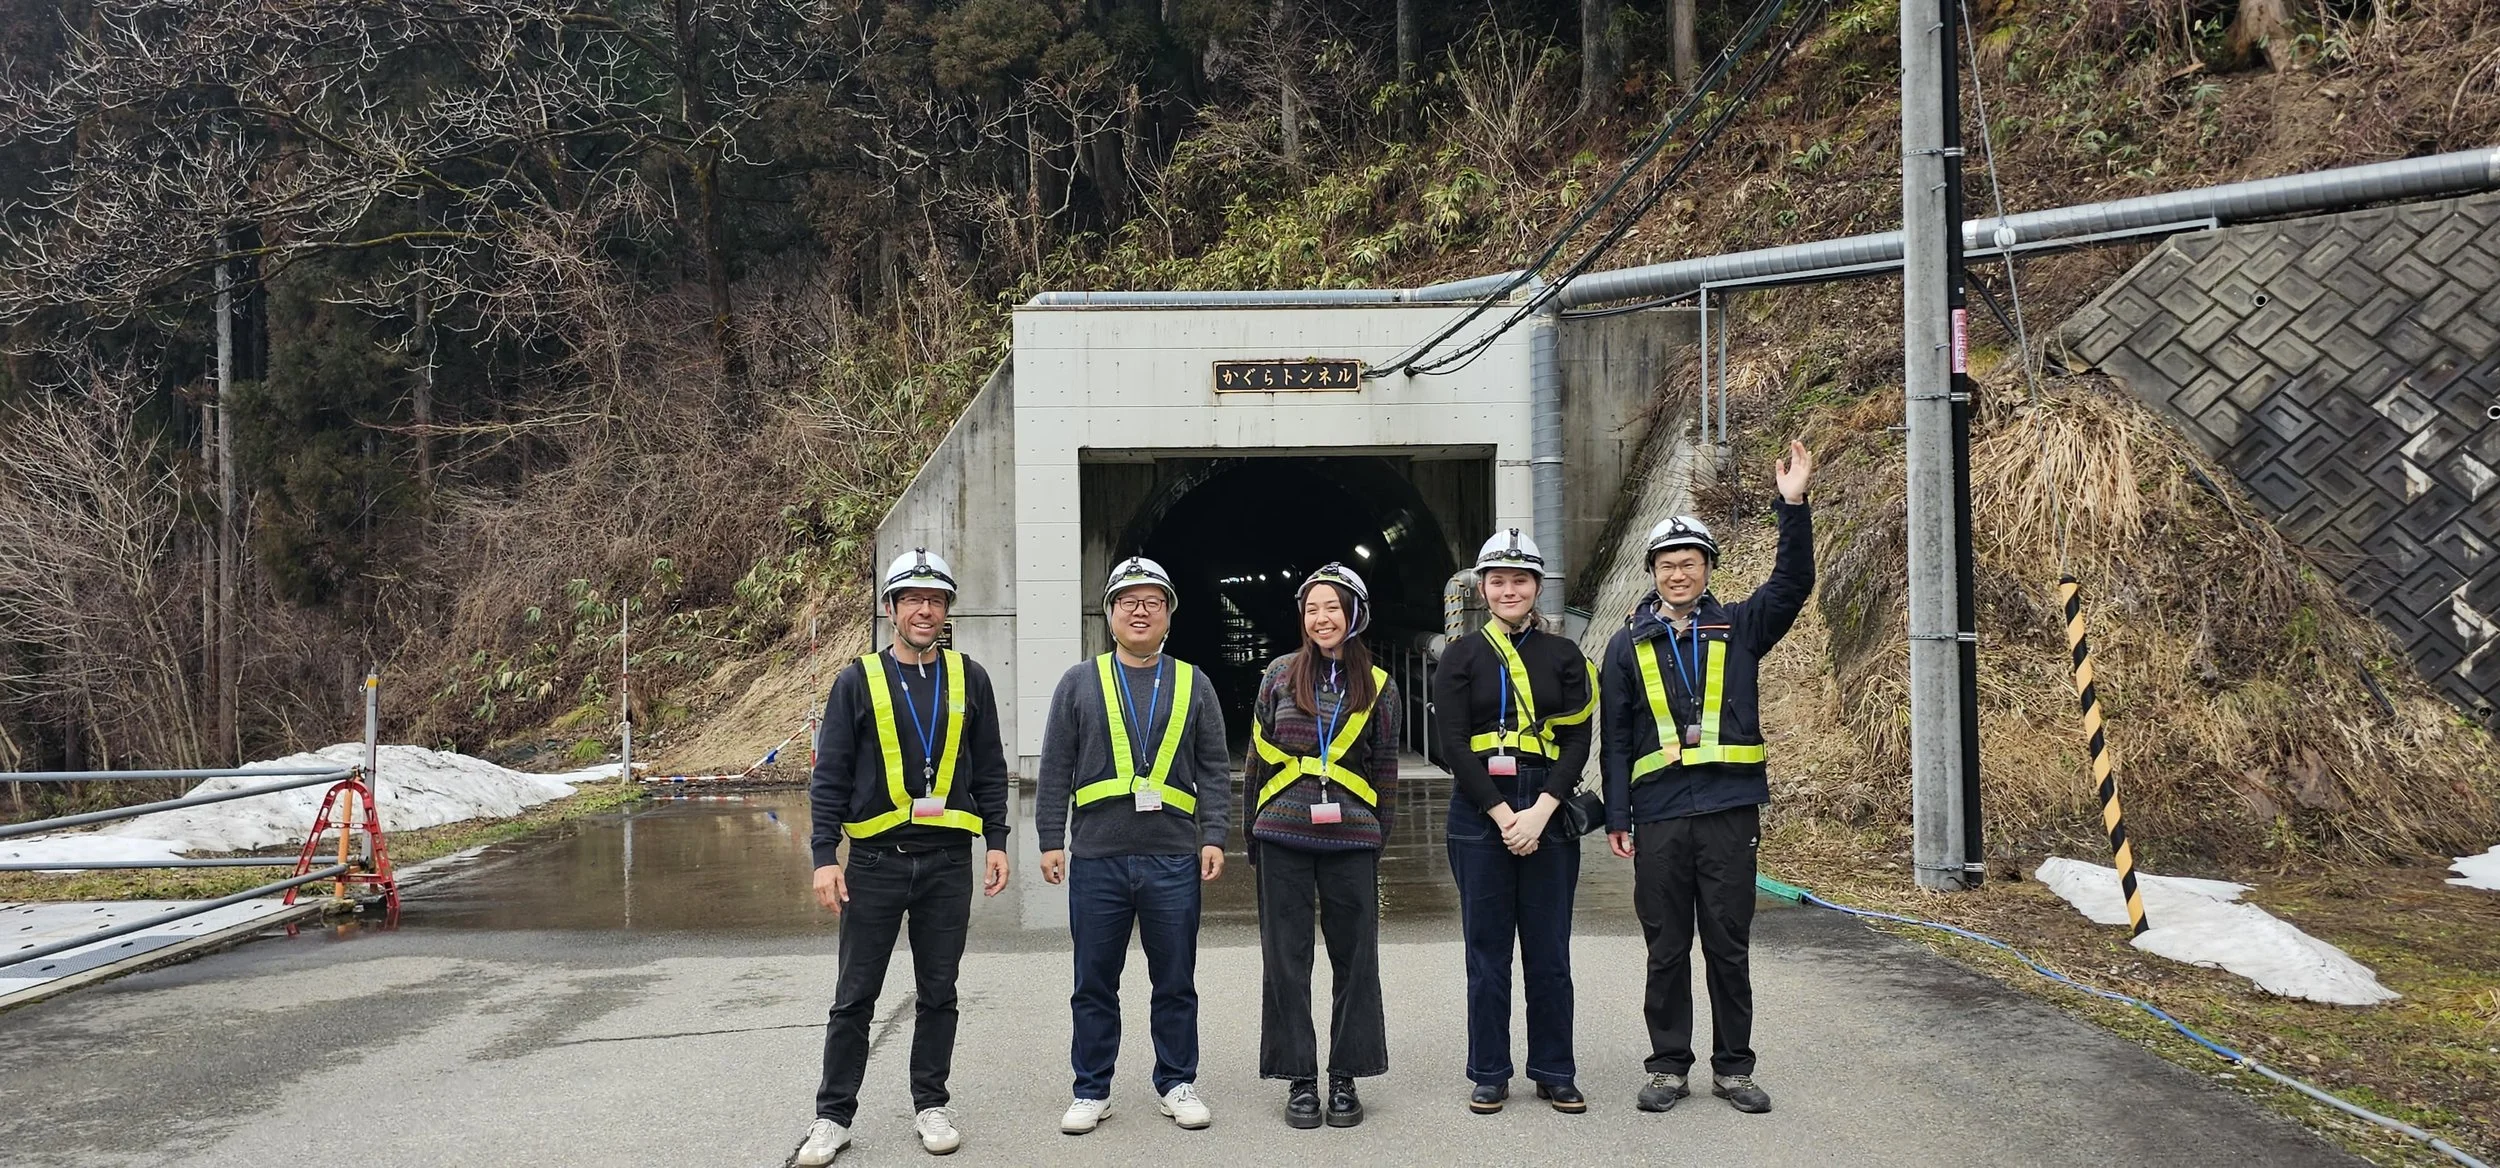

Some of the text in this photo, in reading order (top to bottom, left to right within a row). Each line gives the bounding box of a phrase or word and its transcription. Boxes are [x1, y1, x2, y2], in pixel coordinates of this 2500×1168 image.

[1222, 366, 1352, 386] かぐらトンネル
